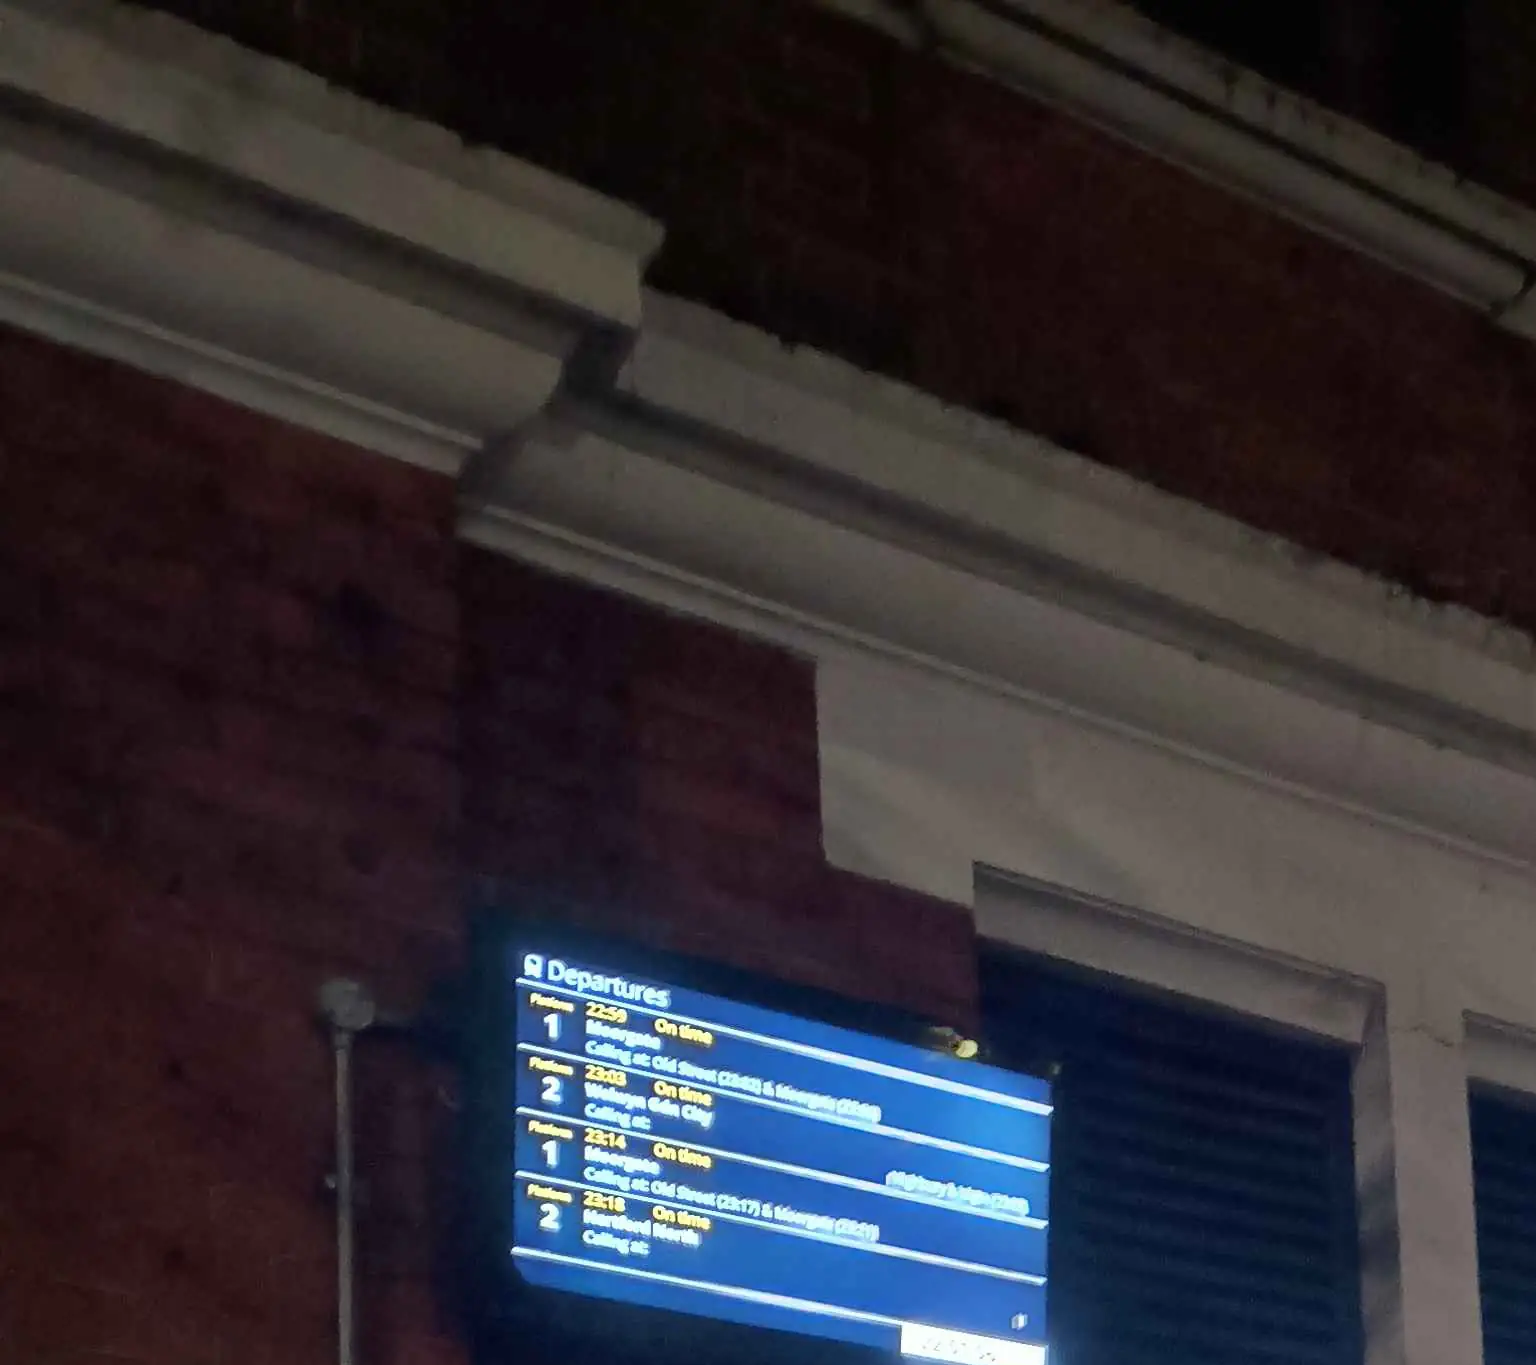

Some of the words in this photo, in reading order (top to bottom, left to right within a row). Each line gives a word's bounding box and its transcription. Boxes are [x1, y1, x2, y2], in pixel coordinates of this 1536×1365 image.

[547, 958, 671, 1009] Departures
[543, 1012, 562, 1041] 1
[585, 1001, 628, 1024] 22:59
[654, 1018, 677, 1036] On
[678, 1024, 713, 1046] time
[541, 1076, 563, 1105] 2
[585, 1064, 628, 1087] 23:03
[654, 1080, 677, 1098] On
[678, 1085, 713, 1107] time
[681, 1104, 715, 1130] City
[542, 1140, 560, 1168] 1
[585, 1128, 627, 1149] 23:14
[653, 1143, 677, 1160] On
[678, 1148, 712, 1169] time
[539, 1203, 562, 1232] 2
[653, 1206, 676, 1223] On
[677, 1211, 711, 1230] time
